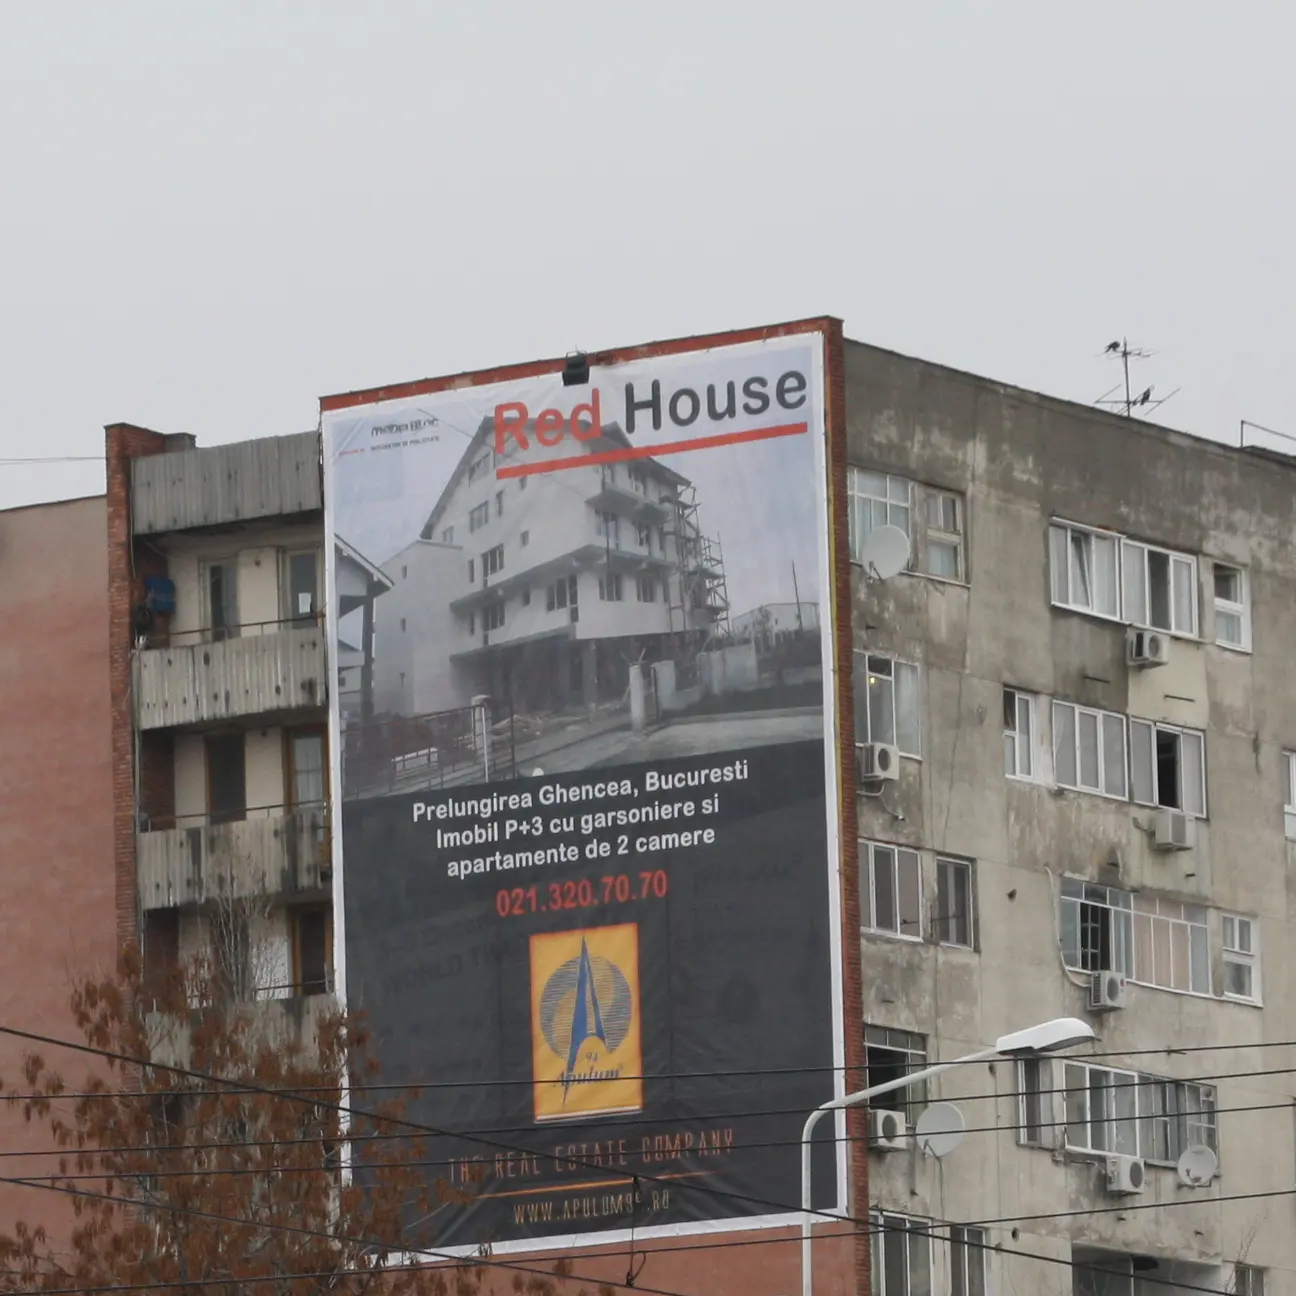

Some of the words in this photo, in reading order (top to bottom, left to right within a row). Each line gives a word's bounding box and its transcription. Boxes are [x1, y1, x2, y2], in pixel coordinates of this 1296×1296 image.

[493, 387, 602, 454] Red
[624, 369, 808, 434] House
[413, 792, 533, 822] Prelungirea
[539, 779, 639, 806] Ghencea,
[645, 760, 749, 791] Bucuresti
[436, 822, 498, 849] Imobil
[505, 816, 544, 840] P+3
[549, 815, 575, 834] cu
[580, 801, 695, 835] garsoniere
[701, 793, 720, 813] si
[447, 843, 579, 880] apartamente
[585, 838, 611, 859] de
[617, 835, 629, 855] 2
[635, 828, 716, 853] camere
[495, 870, 669, 917] 021.320.70.70
[495, 1152, 542, 1178] REAL
[555, 1139, 628, 1172] ESTATE
[641, 1128, 734, 1163] COMPANY
